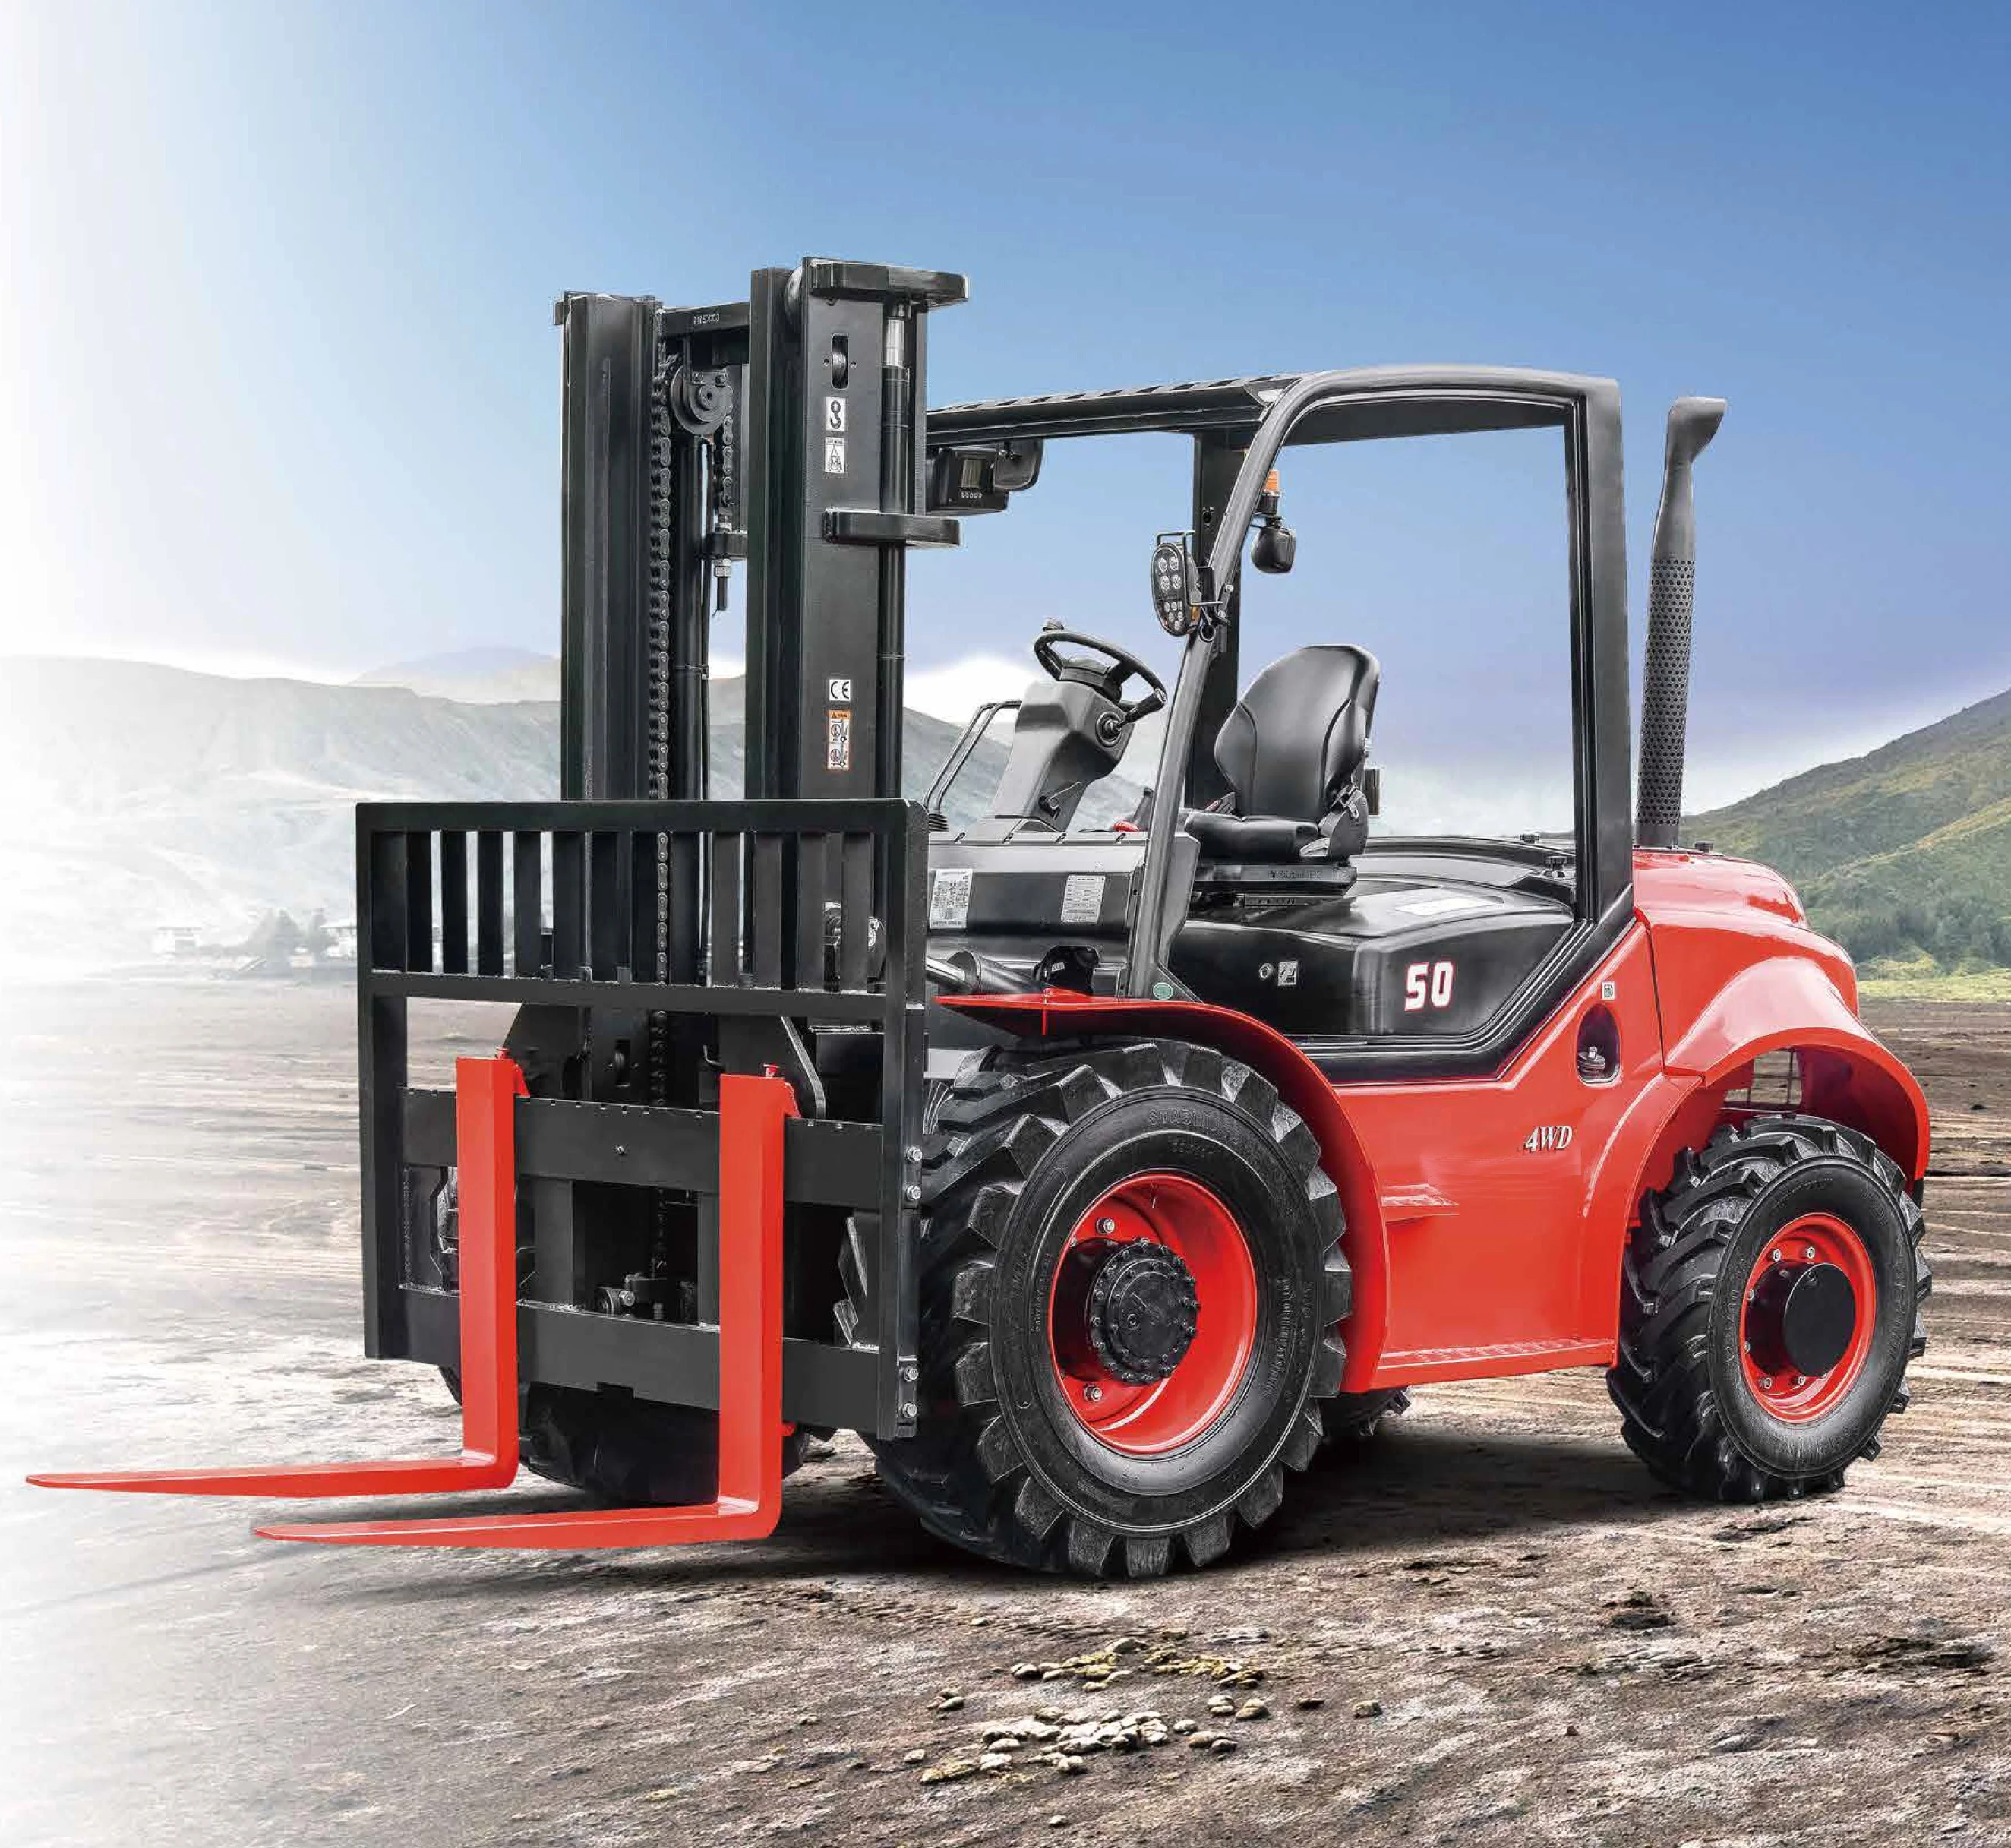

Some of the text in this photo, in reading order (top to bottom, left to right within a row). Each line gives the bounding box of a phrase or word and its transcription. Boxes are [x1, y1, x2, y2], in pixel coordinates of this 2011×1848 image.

[831, 681, 850, 699] CE
[1404, 961, 1454, 1011] 50
[1524, 1126, 1573, 1152] 4WD
